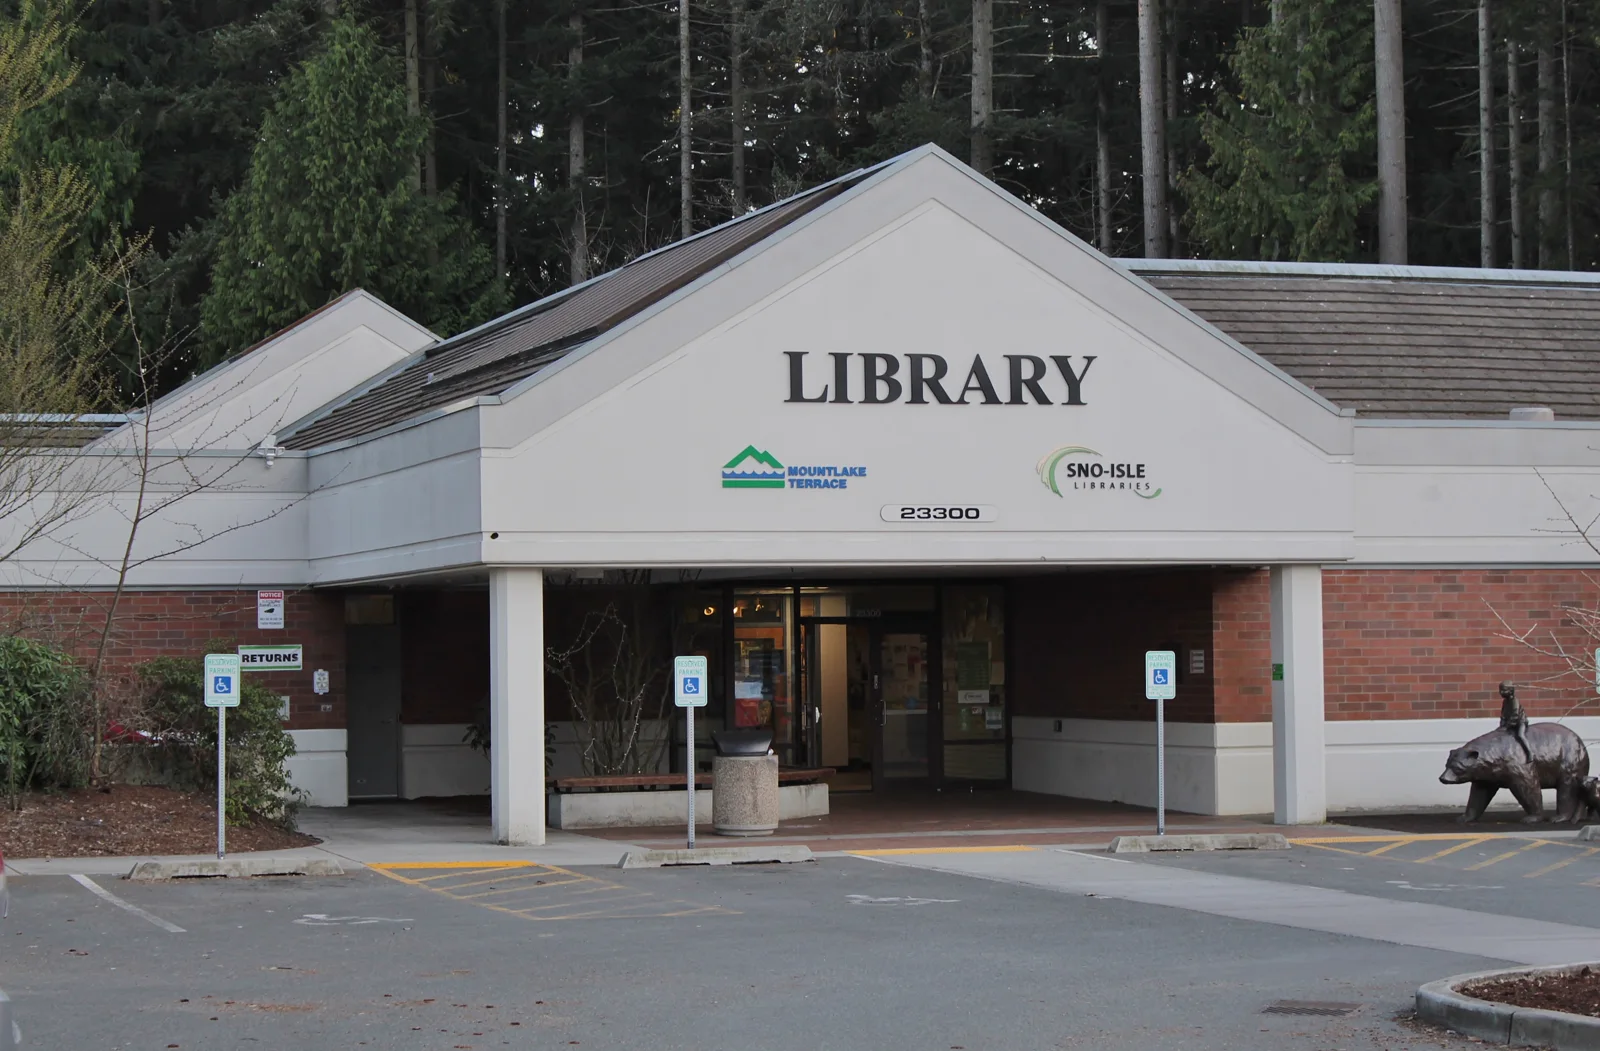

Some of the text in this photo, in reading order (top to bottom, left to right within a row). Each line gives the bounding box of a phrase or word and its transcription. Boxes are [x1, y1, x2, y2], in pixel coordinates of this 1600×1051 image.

[783, 351, 1098, 406] LIBRARY
[787, 465, 868, 478] MOUNTLAKE
[1066, 463, 1146, 479] SNO-ISLE
[788, 478, 848, 489] TERRACE
[1073, 481, 1151, 491] LIBRARIES
[900, 507, 980, 520] 23300
[242, 653, 299, 663] RETURNS
